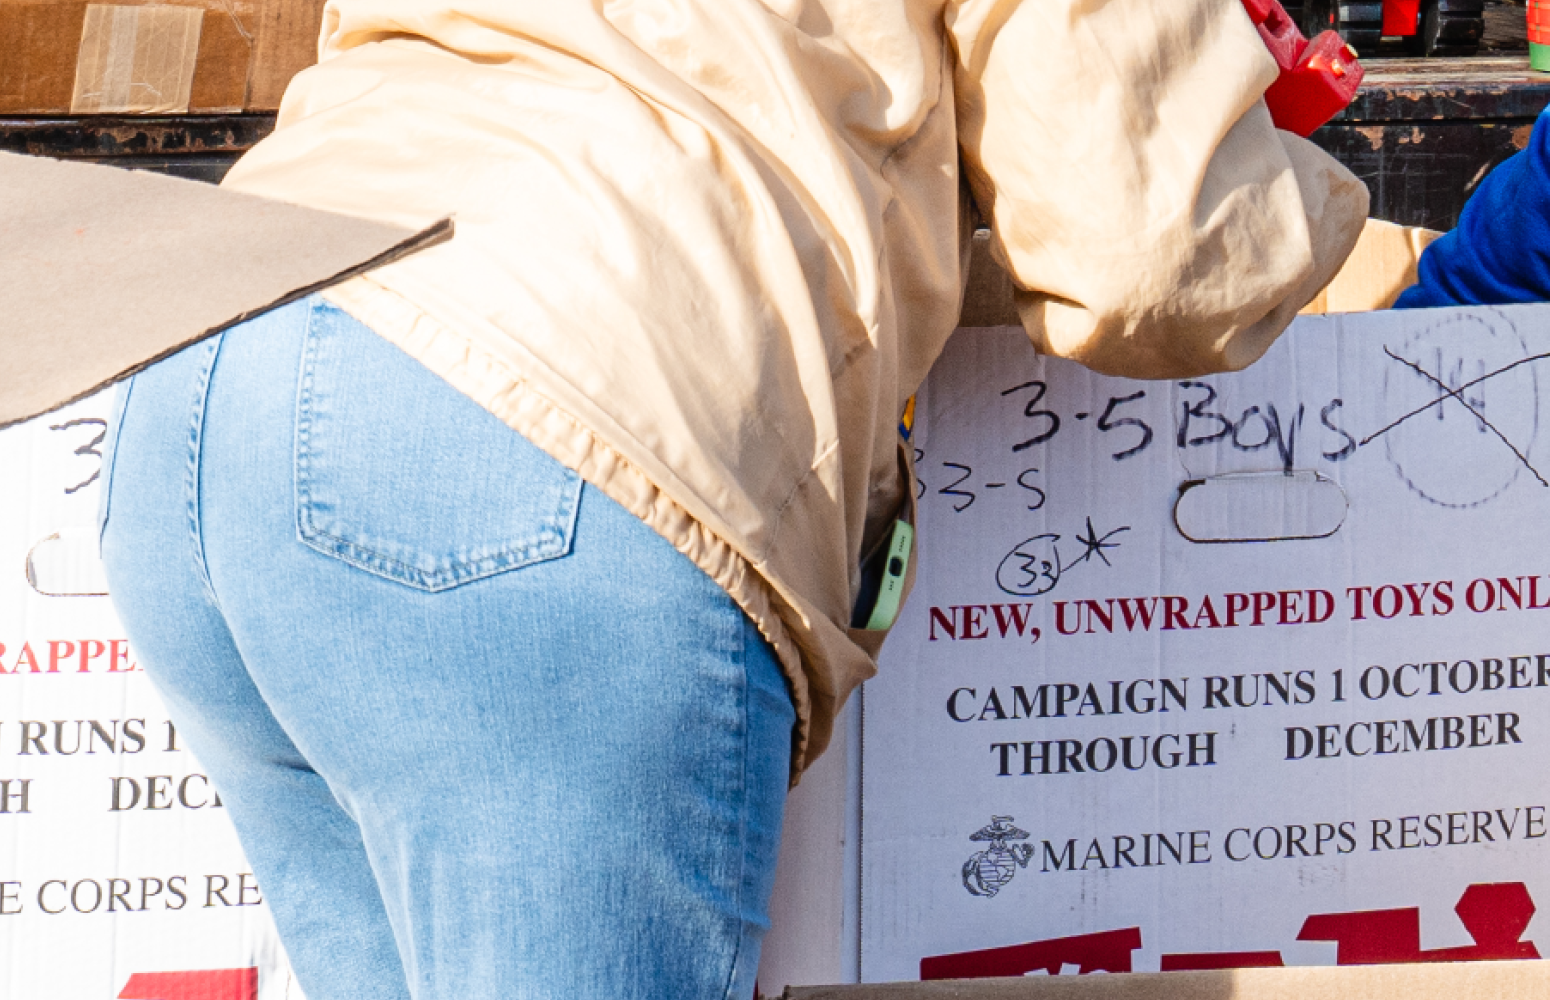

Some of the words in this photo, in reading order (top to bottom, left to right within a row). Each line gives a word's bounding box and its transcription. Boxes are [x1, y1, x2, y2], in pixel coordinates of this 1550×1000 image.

[1001, 380, 1154, 462] 3-5
[928, 602, 1043, 645] NEW,
[1054, 591, 1335, 636] UNWRAPPED
[1346, 582, 1455, 623] TOYS
[946, 677, 1189, 725] CAMPAIGN
[1203, 669, 1316, 711] RUNS
[1330, 668, 1346, 702] 1
[17, 718, 145, 756] RUNS
[991, 731, 1218, 777] THROUGH
[1284, 712, 1523, 762] DECEMBER
[1040, 828, 1212, 874] MARINE
[1223, 820, 1358, 861] CORPS
[1369, 805, 1548, 853] RESERVE
[37, 876, 188, 915] CORPS
